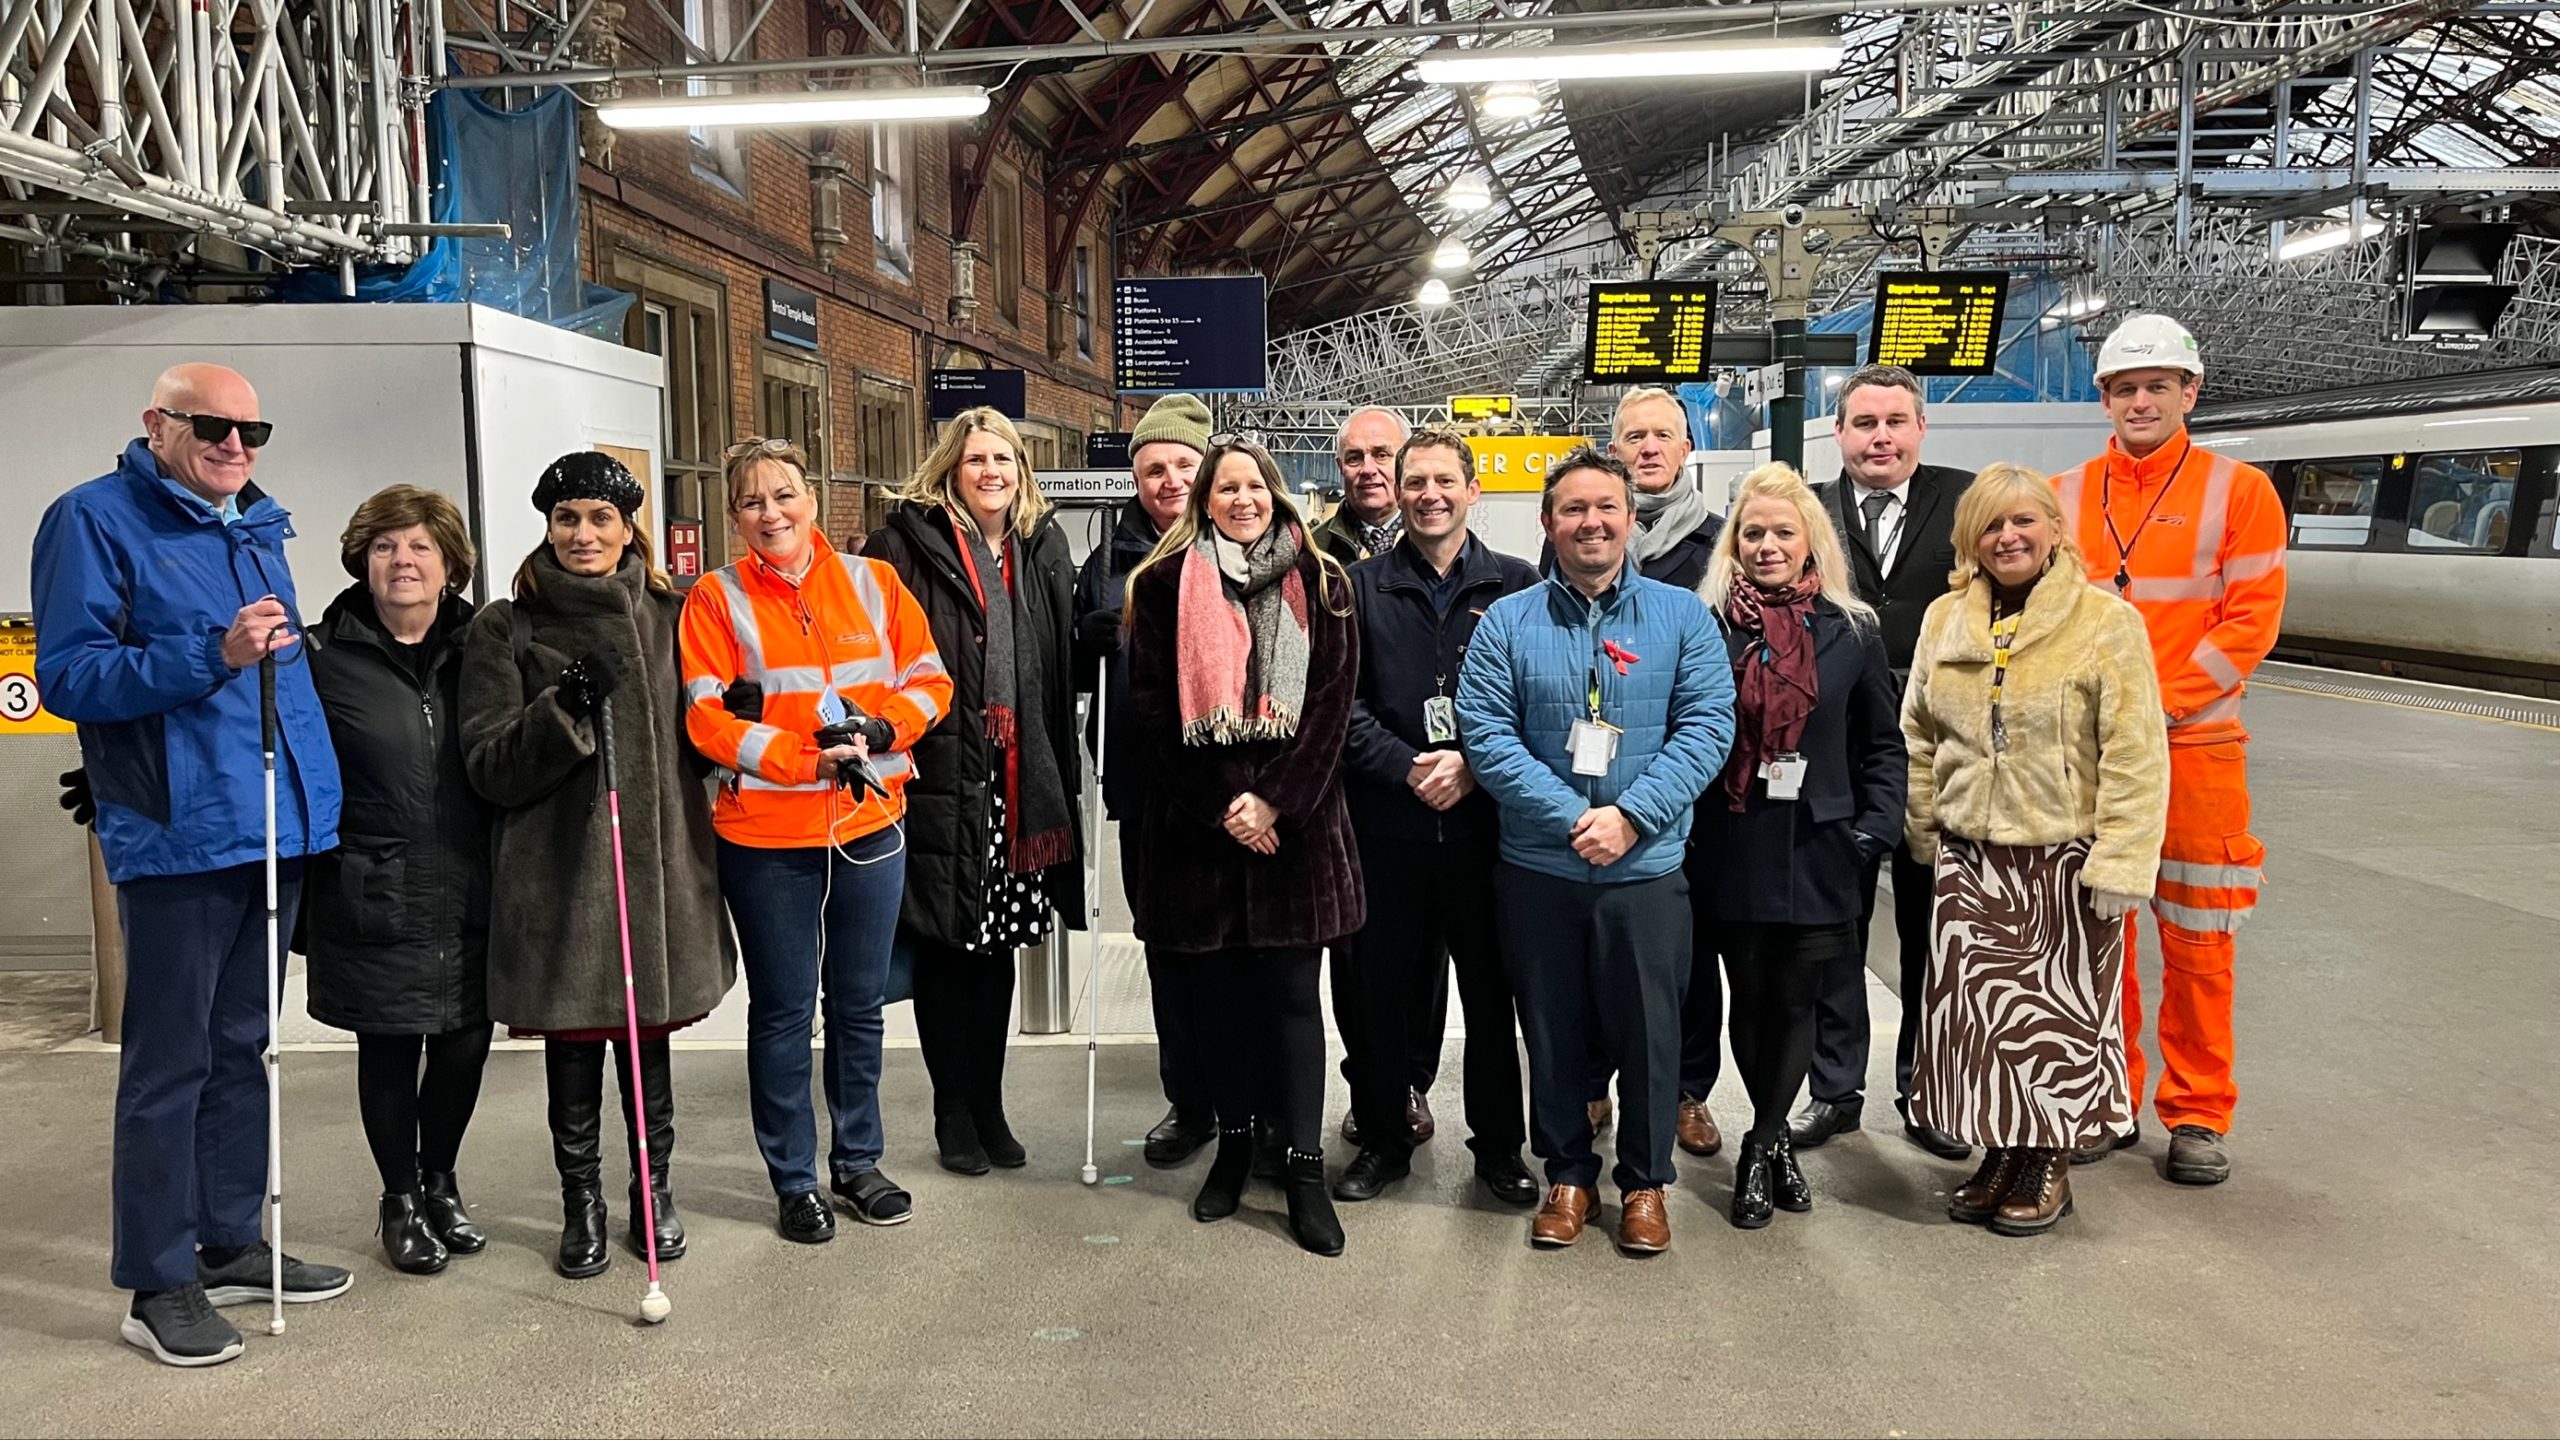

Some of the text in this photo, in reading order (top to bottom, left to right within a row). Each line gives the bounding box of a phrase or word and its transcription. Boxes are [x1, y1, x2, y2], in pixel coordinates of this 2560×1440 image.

[1888, 284, 1940, 294] Departures
[1599, 293, 1650, 303] Departures
[772, 299, 816, 326] Bristol Temple Meads
[1478, 452, 1508, 474] ER
[1106, 478, 1134, 490] Poin
[7, 682, 28, 712] 3
